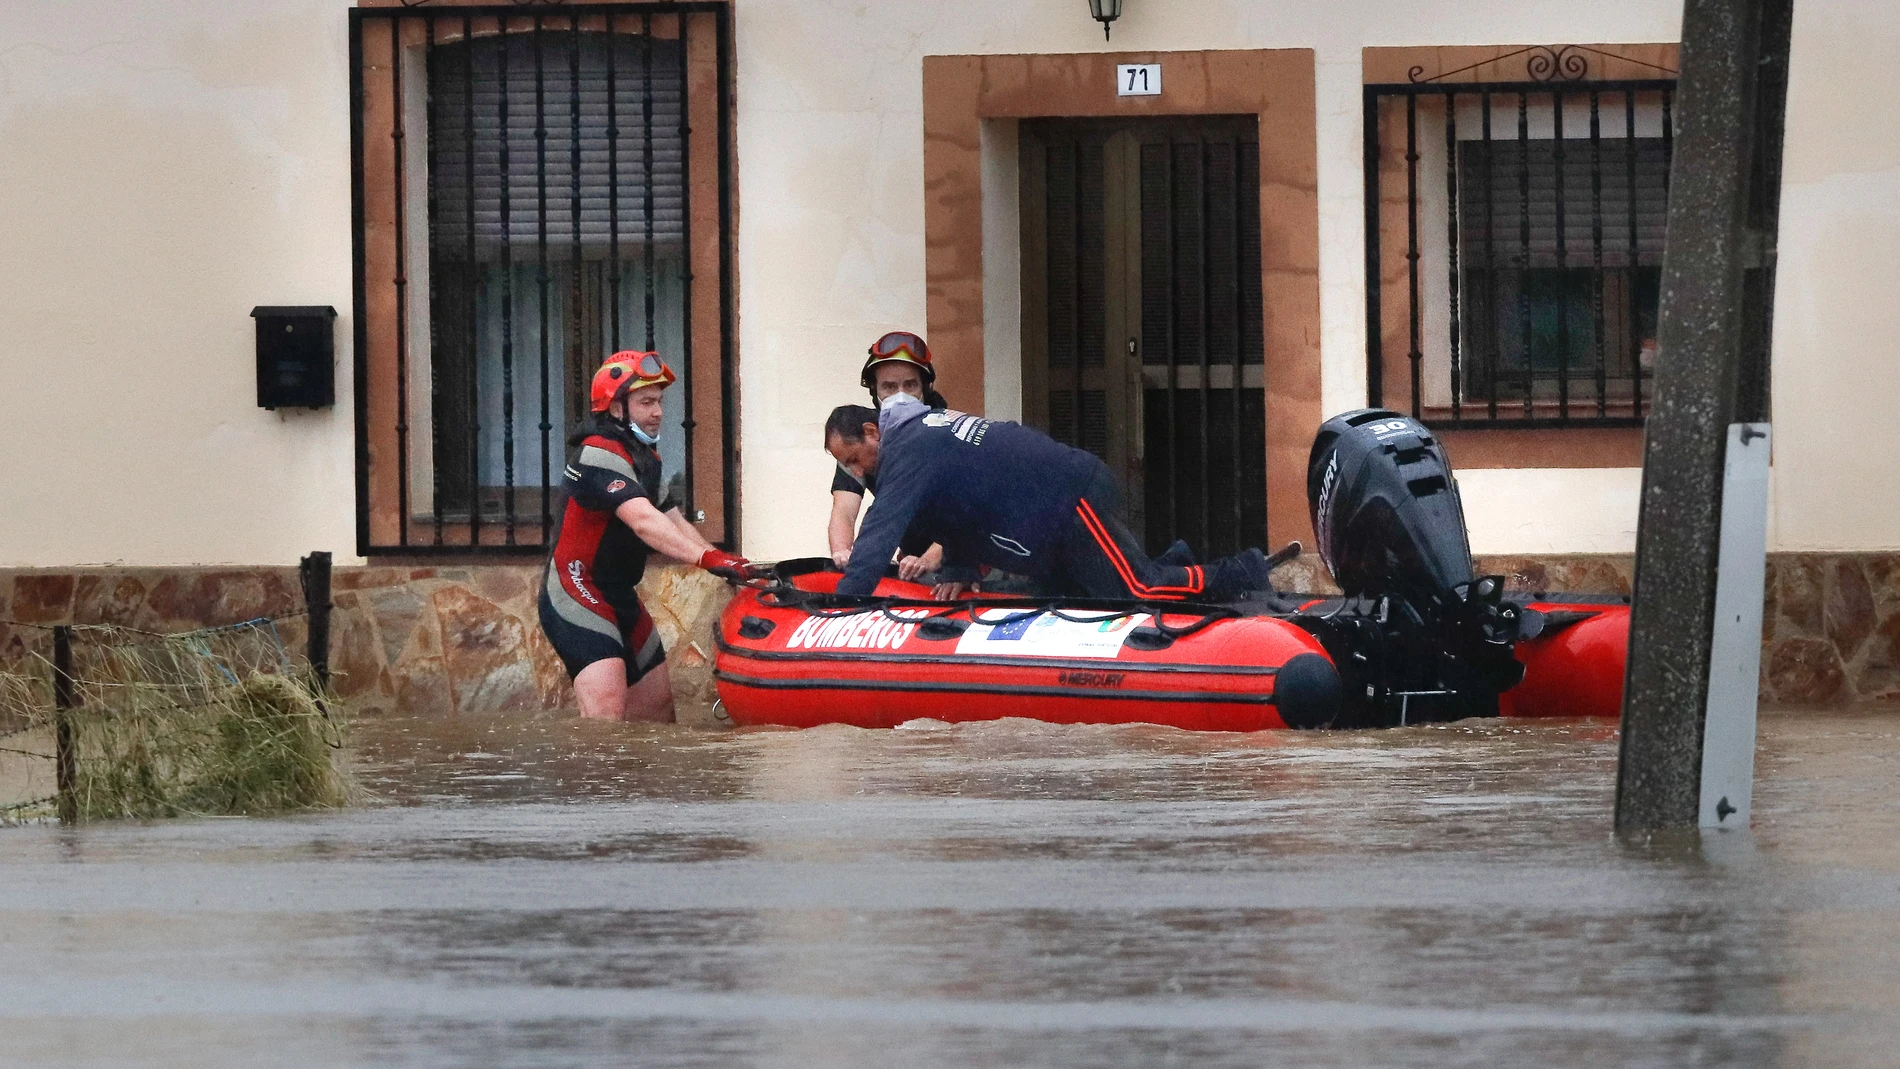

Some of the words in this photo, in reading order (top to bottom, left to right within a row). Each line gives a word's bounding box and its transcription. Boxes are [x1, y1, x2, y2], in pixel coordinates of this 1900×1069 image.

[1126, 68, 1148, 91] 71
[1369, 420, 1407, 435] 30
[567, 559, 599, 605] Subacqua
[785, 609, 930, 650] BOMBEROS
[1068, 672, 1127, 687] MERCURY
